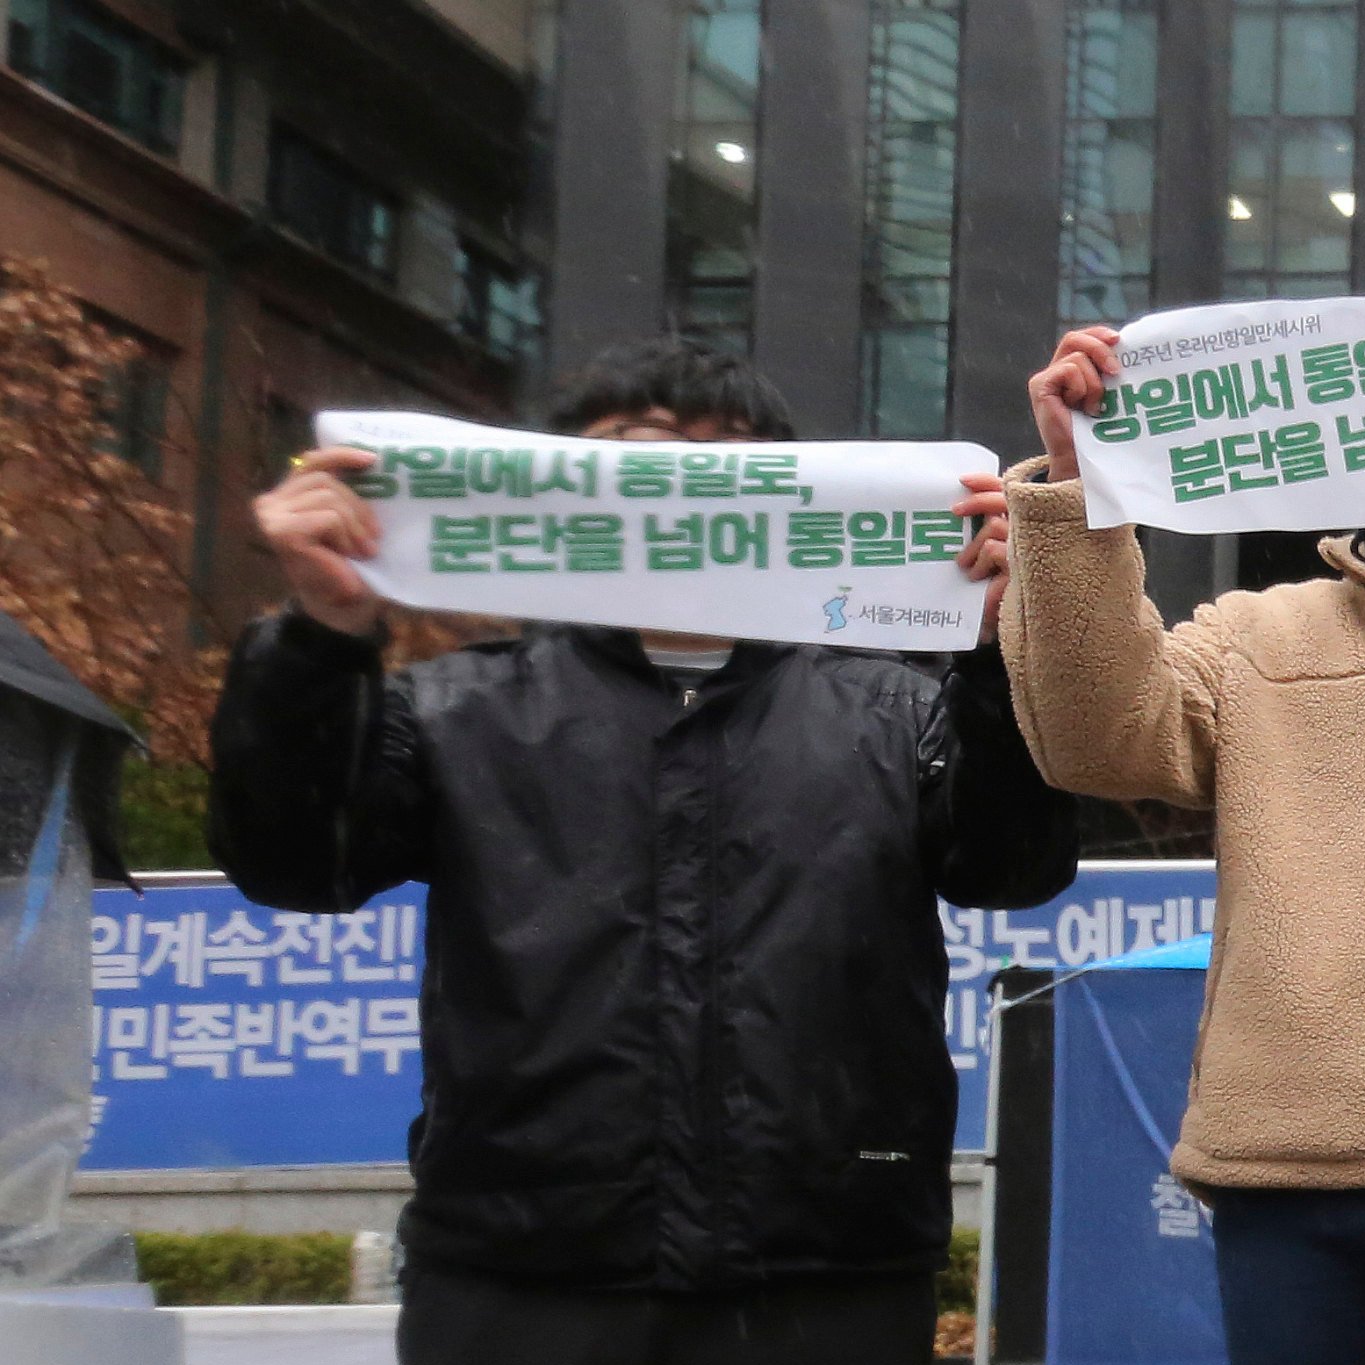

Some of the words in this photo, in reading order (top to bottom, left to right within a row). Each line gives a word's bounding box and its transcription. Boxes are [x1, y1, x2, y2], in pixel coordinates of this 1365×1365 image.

[1116, 341, 1174, 369] 02주년
[1176, 315, 1323, 357] 온라인항일만세시위
[1092, 353, 1295, 442] 항일에서
[615, 451, 813, 507] 통일로,
[1168, 419, 1327, 504] 분단을
[429, 510, 626, 574] 분단을
[645, 512, 769, 570] 넘어
[859, 605, 962, 628] 서울겨레하나
[92, 998, 421, 1082] 민족반역무
